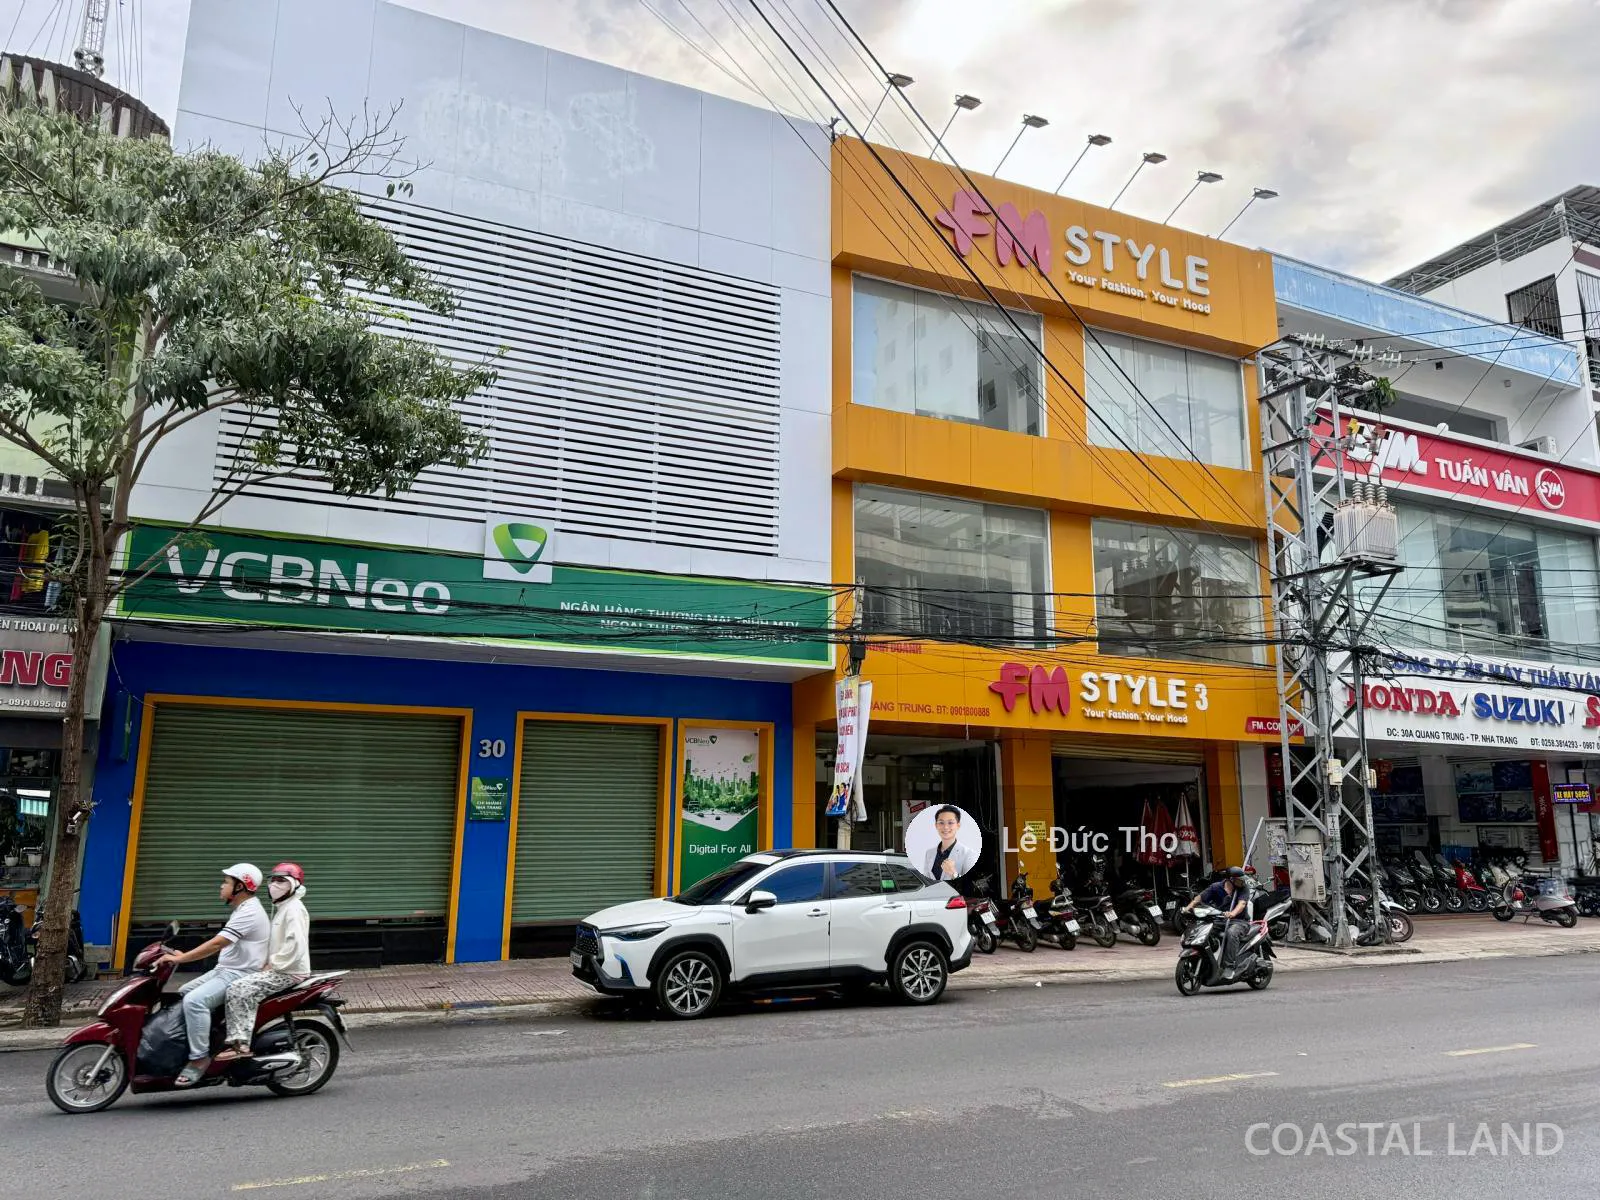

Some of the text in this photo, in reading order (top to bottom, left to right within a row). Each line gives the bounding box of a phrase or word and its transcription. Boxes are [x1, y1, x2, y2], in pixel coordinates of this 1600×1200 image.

[935, 189, 1210, 296] FM STYLE
[1068, 270, 1211, 315] Your Fashion. Your Mood
[1435, 457, 1529, 496] TUẤN VÂN
[1540, 480, 1564, 499] SYM
[167, 543, 452, 616] VCBNeo
[560, 601, 600, 613] NGÂN
[14, 620, 46, 632] THOẠI
[989, 662, 1209, 717] FM STYLE 3
[871, 701, 894, 712] ANG
[898, 702, 935, 714] TRUNG.
[936, 705, 948, 715] ĐT:
[1347, 683, 1460, 717] HONDA
[1472, 692, 1566, 725] SUZUKI
[1082, 707, 1189, 725] Your Fashion. Your Mood
[1386, 727, 1399, 738] ĐC:
[1401, 728, 1414, 738] 30A
[1415, 729, 1440, 740] QUANG
[1441, 731, 1464, 741] TRUNG
[1471, 733, 1480, 743] TP.
[1481, 734, 1495, 743] NHA
[1496, 735, 1518, 745] TRANG
[478, 739, 506, 758] 30
[689, 843, 751, 857] Digital For All
